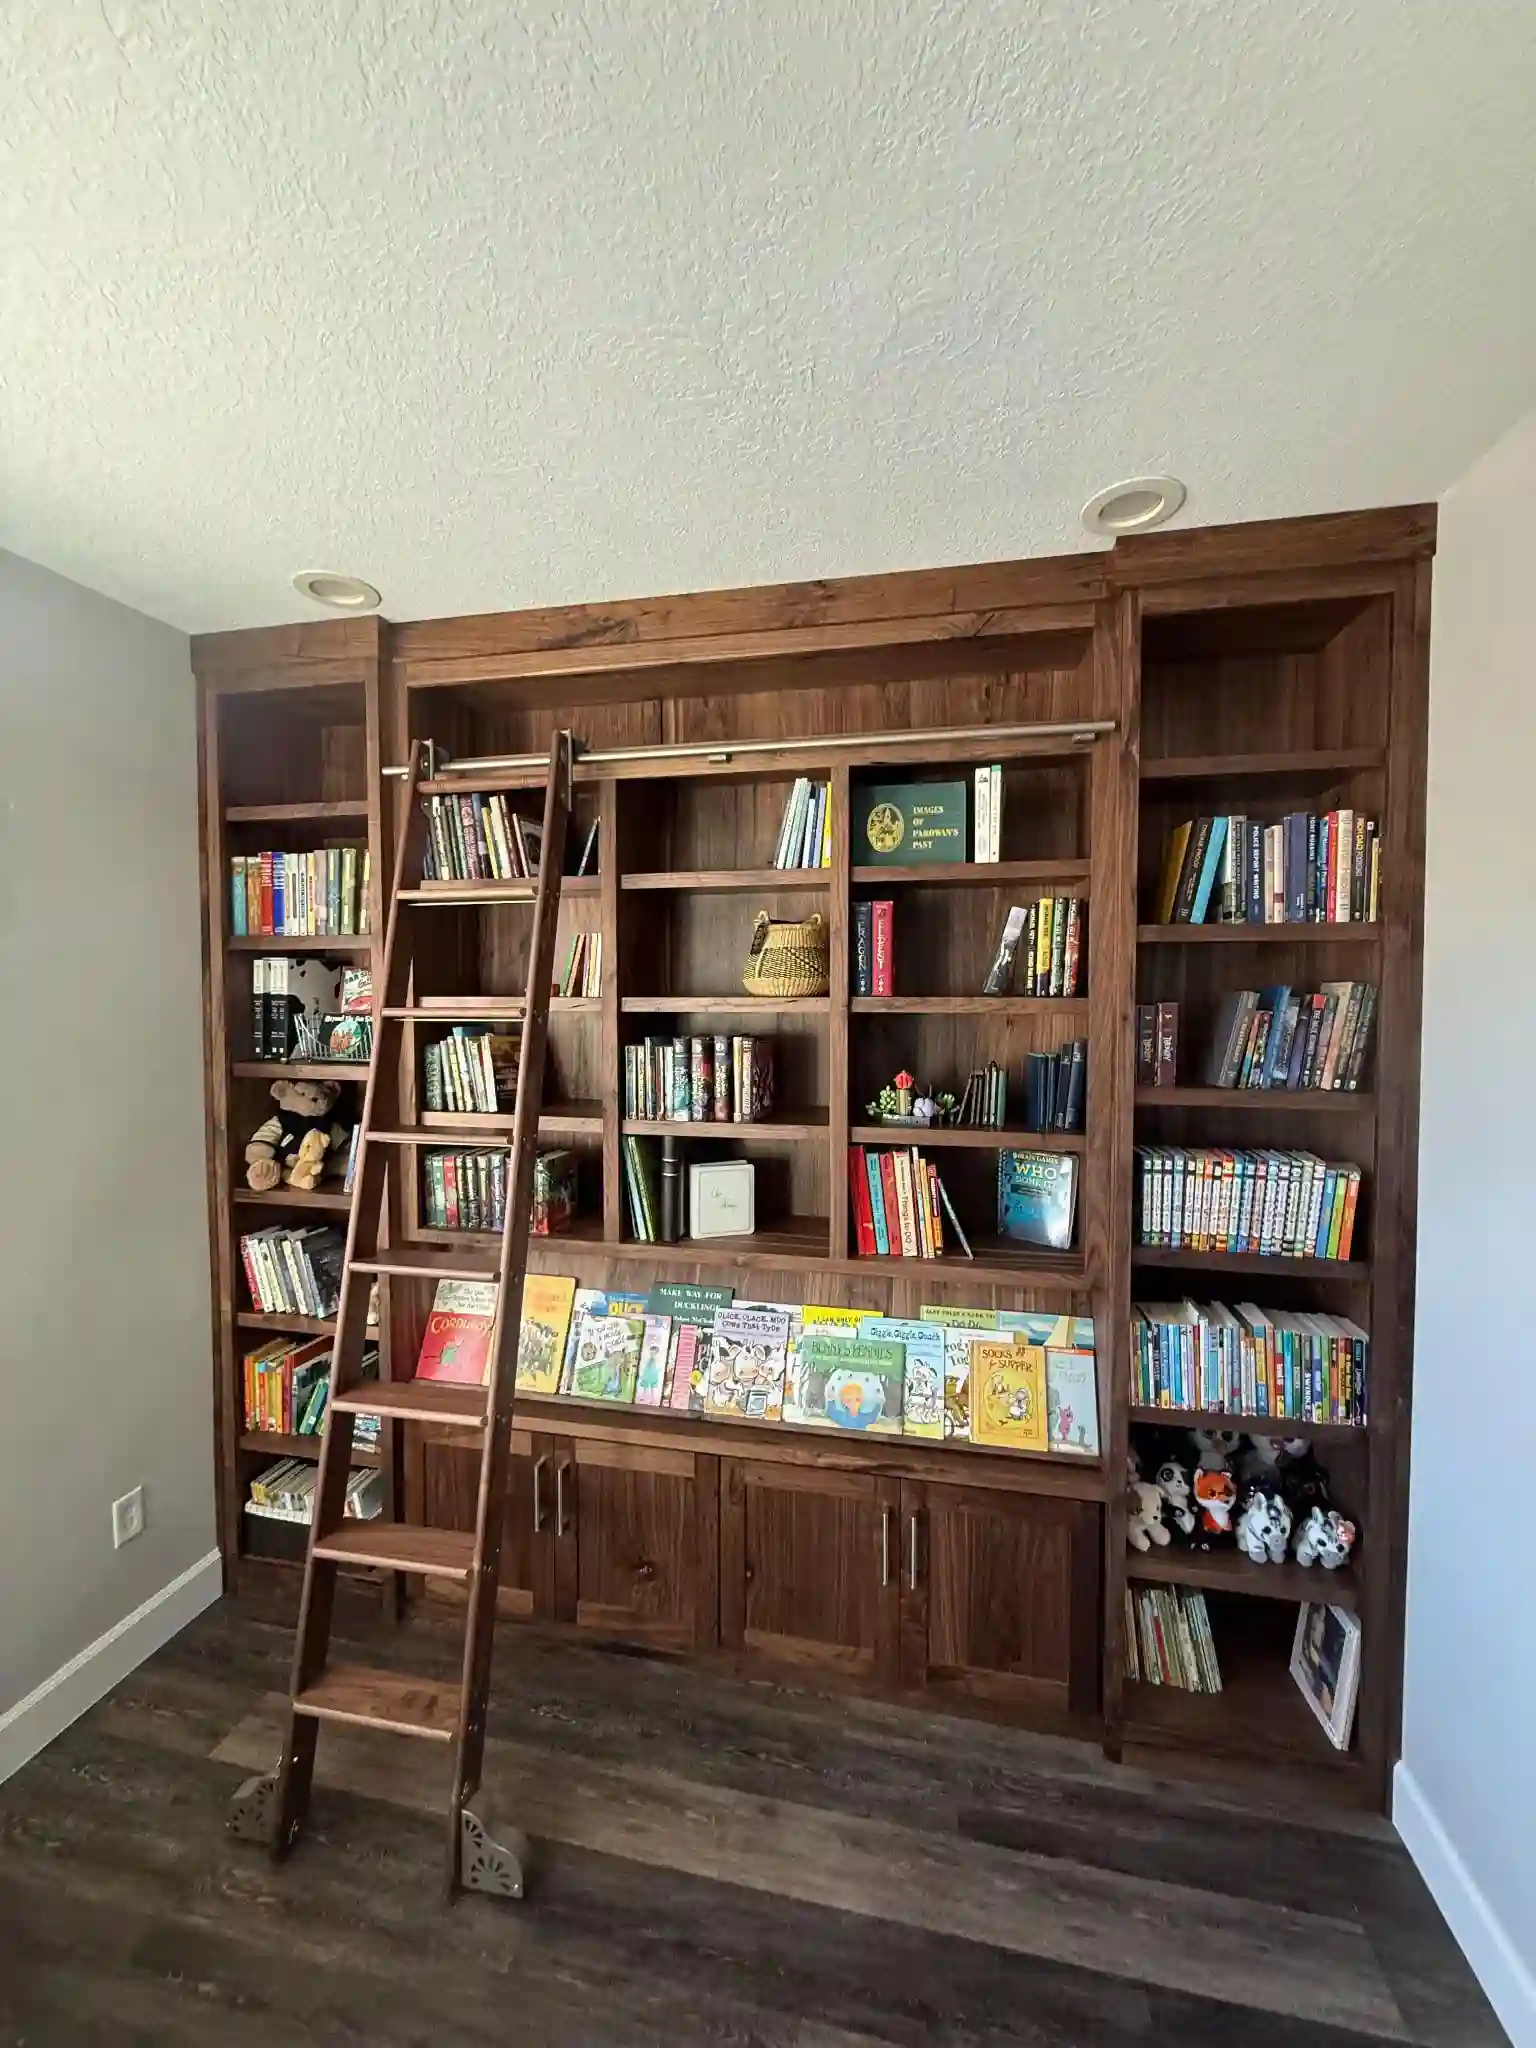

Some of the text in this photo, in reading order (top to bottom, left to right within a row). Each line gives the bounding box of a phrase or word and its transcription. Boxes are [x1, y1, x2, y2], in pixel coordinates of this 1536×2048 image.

[912, 805, 945, 814] IMAGES
[912, 817, 925, 826] OF
[912, 829, 960, 837] PAROWAN'S
[912, 840, 934, 849] PAST
[1252, 825, 1260, 900] POLICE REPORT WRITING
[1014, 1162, 1057, 1180] WHO
[901, 1196, 910, 1221] Things
[659, 1287, 723, 1300] MAKE WAY FOR
[721, 1320, 781, 1333] Cows That Type
[769, 1316, 786, 1324] MOO
[943, 1339, 966, 1353] rog
[981, 1348, 1013, 1360] SOCKS
[998, 1359, 1034, 1373] SUPPER
